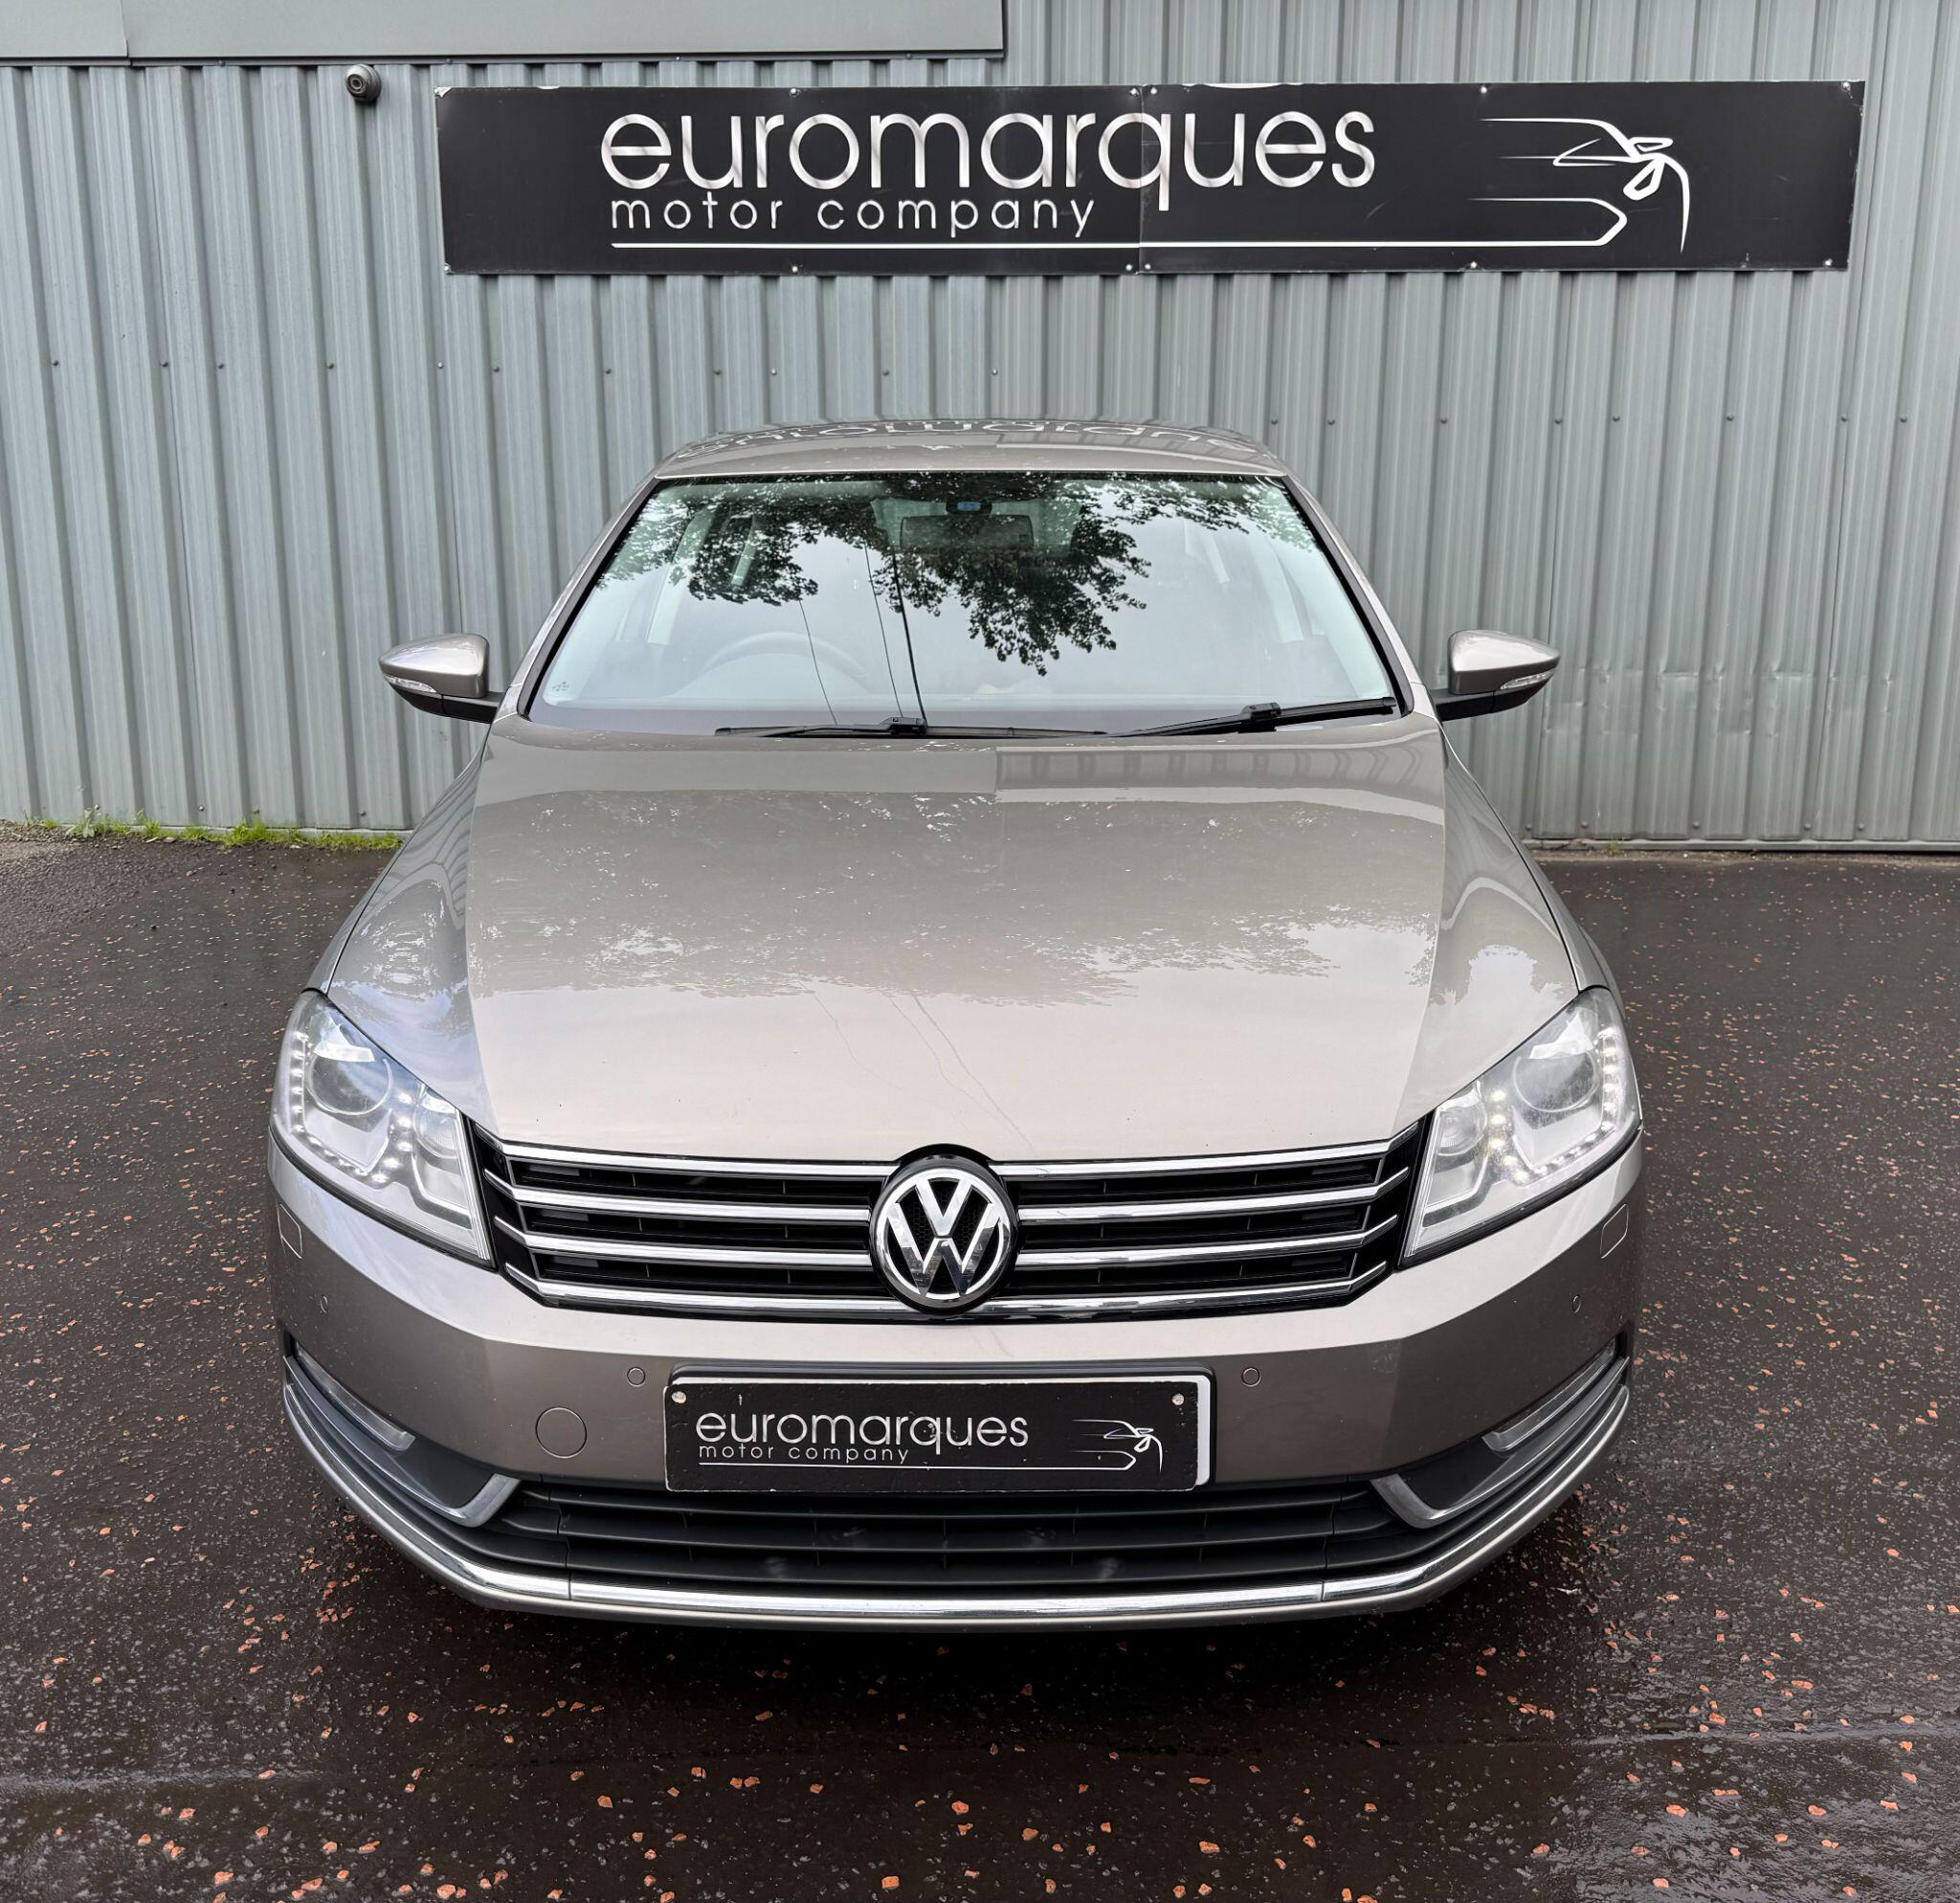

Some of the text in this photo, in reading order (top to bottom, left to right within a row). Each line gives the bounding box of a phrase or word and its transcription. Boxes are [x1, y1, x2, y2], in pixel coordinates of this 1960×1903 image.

[600, 111, 1375, 212] euromarques
[611, 191, 1095, 238] motor company
[882, 1174, 1005, 1296] VW
[695, 1412, 1029, 1456] euromarques
[699, 1444, 909, 1465] motor company
